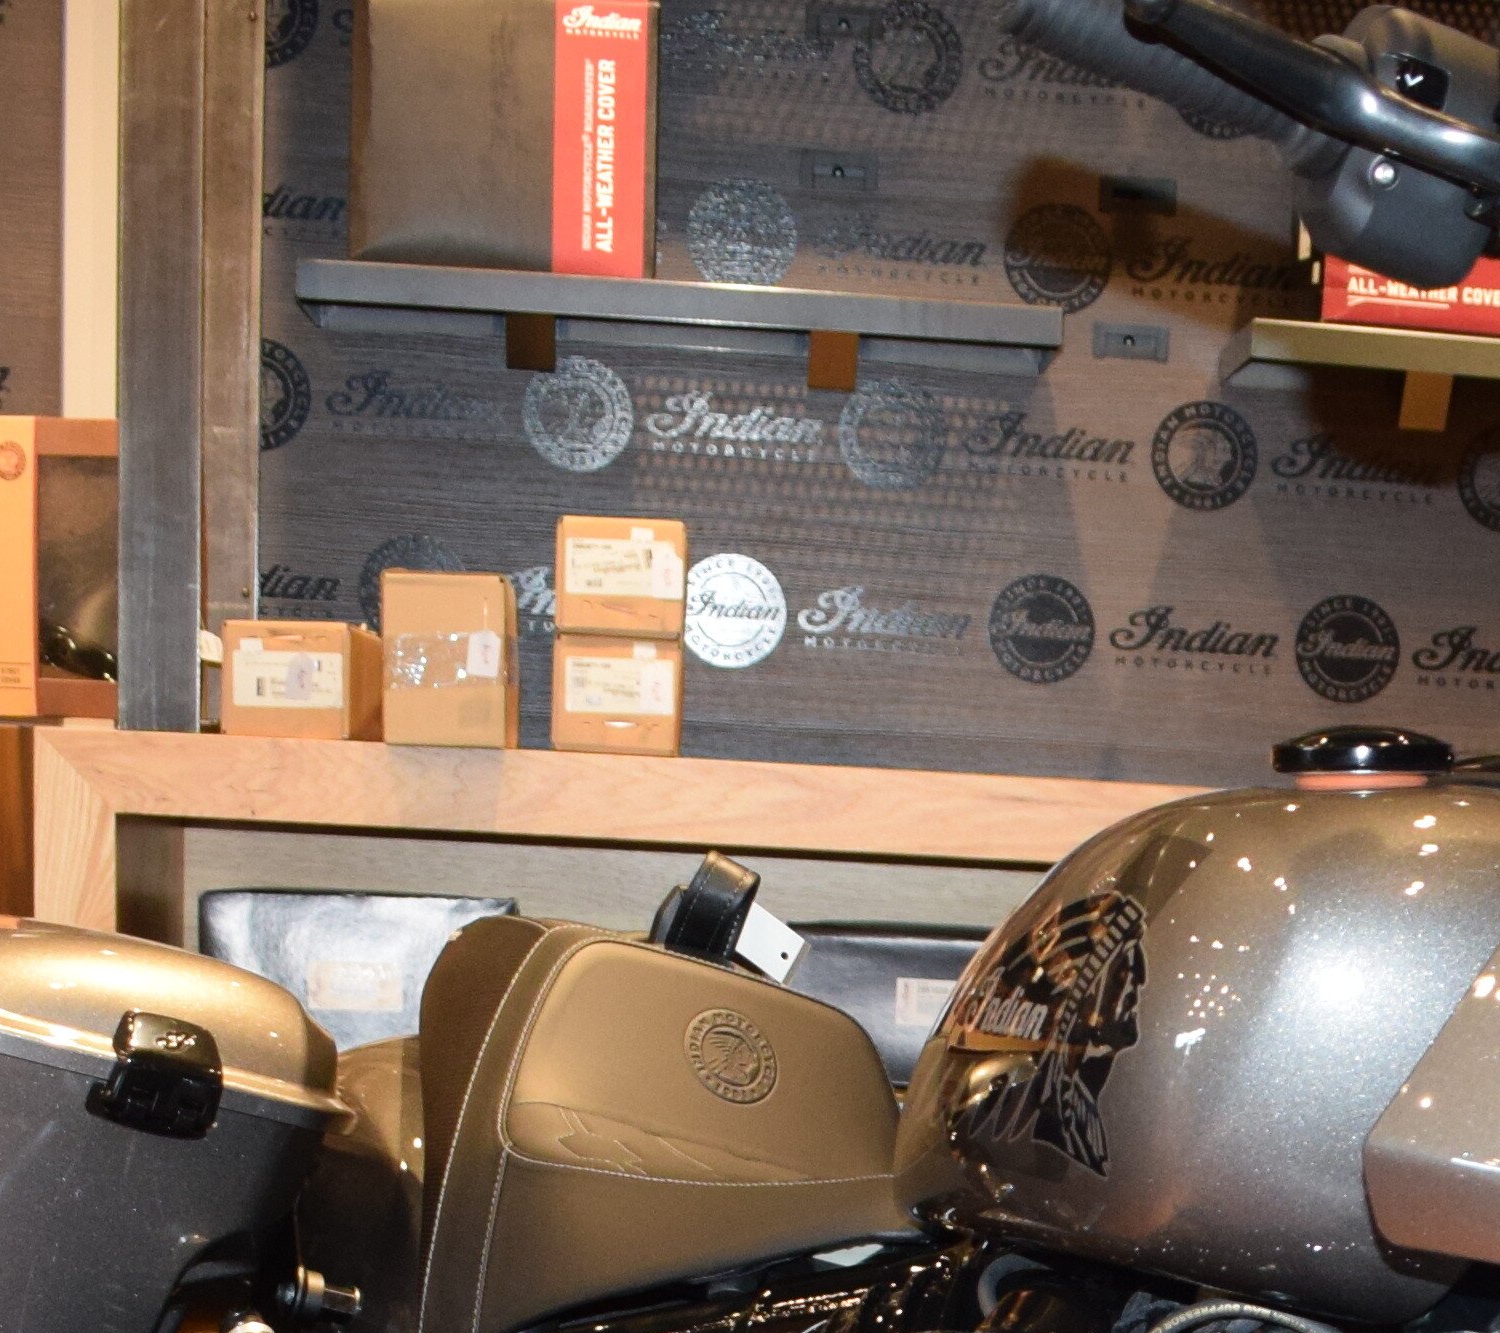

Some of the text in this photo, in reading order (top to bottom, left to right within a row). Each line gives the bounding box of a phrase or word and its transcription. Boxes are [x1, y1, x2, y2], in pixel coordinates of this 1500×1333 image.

[563, 5, 642, 32] Indian
[595, 58, 617, 253] ALL-WEATHER COVER
[646, 390, 823, 446] Indian
[964, 412, 1135, 465] Indian
[685, 589, 780, 621] Indian
[1109, 605, 1280, 658] Indian
[1297, 628, 1396, 660] Indian
